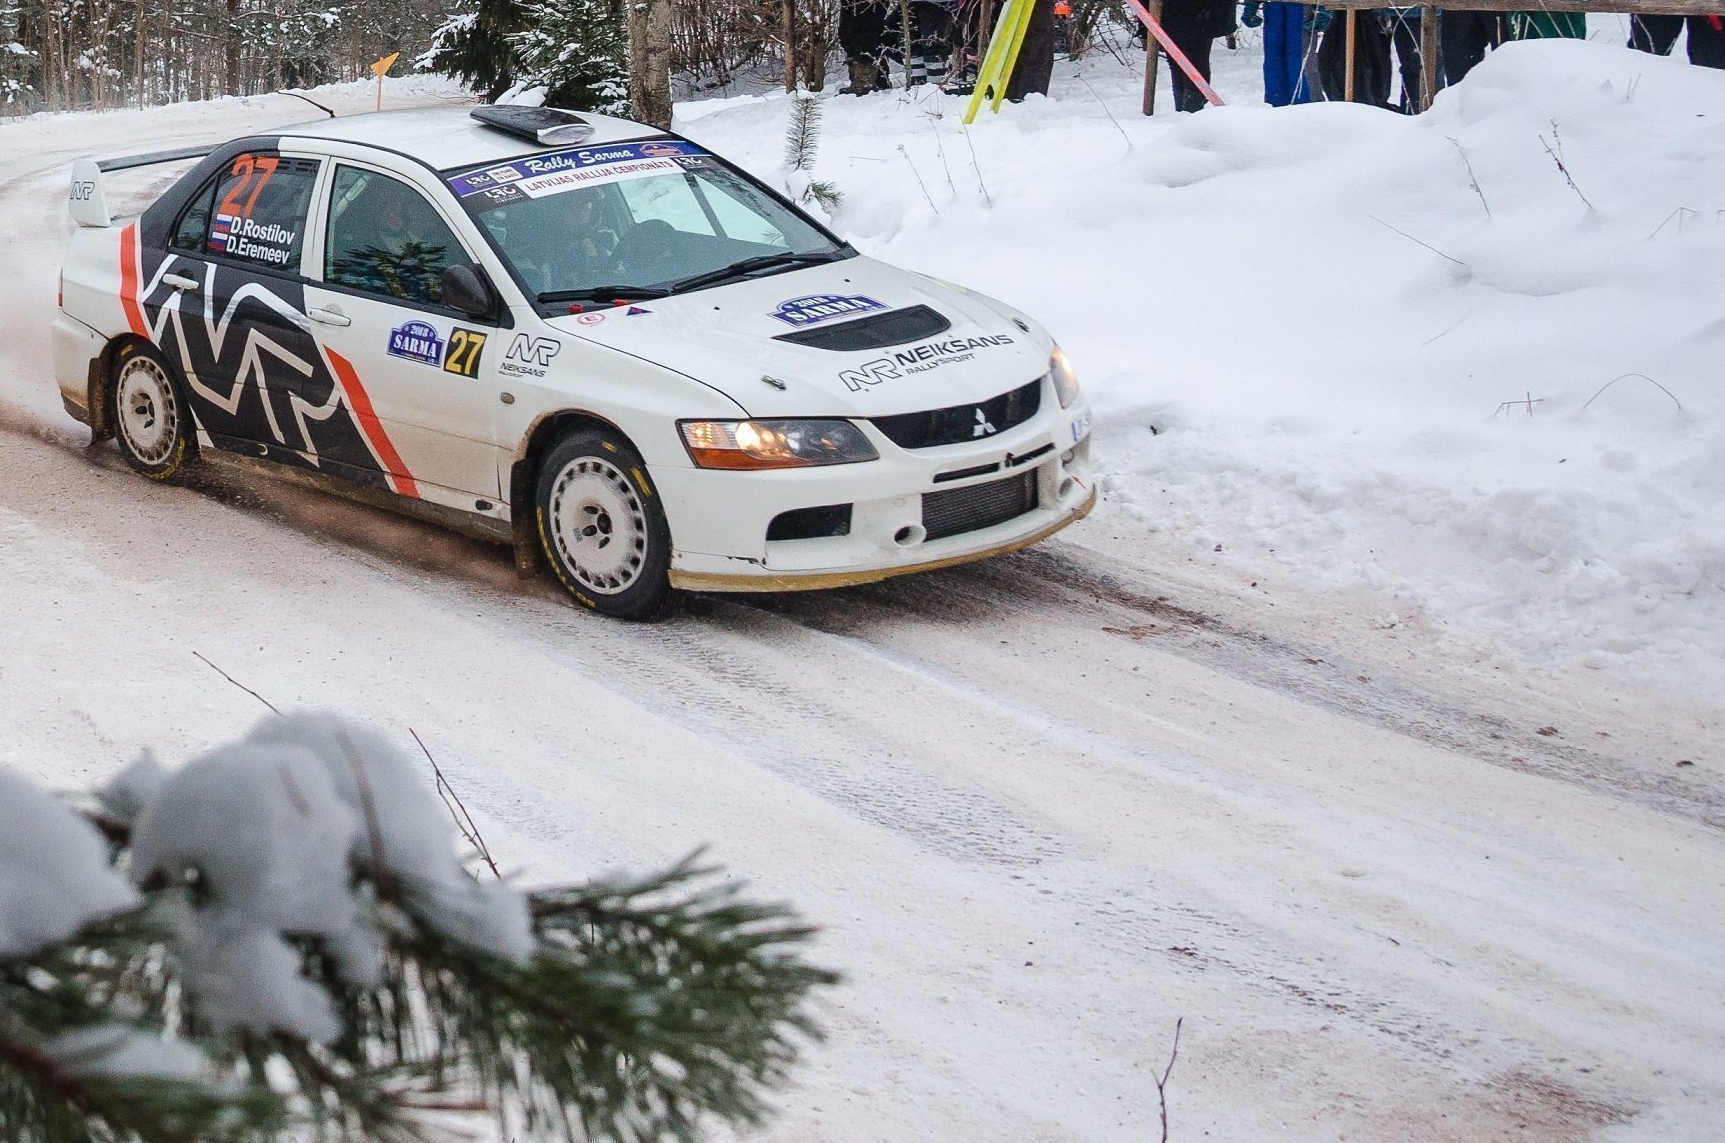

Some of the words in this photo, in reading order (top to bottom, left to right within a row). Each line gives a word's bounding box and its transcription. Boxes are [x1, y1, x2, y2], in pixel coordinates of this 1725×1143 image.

[524, 156, 576, 174] Rally
[578, 150, 634, 164] Sarma
[219, 154, 279, 218] 27
[525, 174, 574, 191] LATVIJAS
[574, 169, 614, 183] RALLIJA
[230, 216, 295, 245] D.Rostilov
[226, 235, 290, 264] D.Eremeev
[785, 298, 872, 321] SARMA
[792, 297, 830, 307] 2018
[410, 325, 429, 337] 2018
[393, 334, 437, 358] SARMA
[445, 330, 485, 375] 27
[894, 334, 1015, 367] NEIKSANS
[500, 362, 546, 378] NEIKSANS
